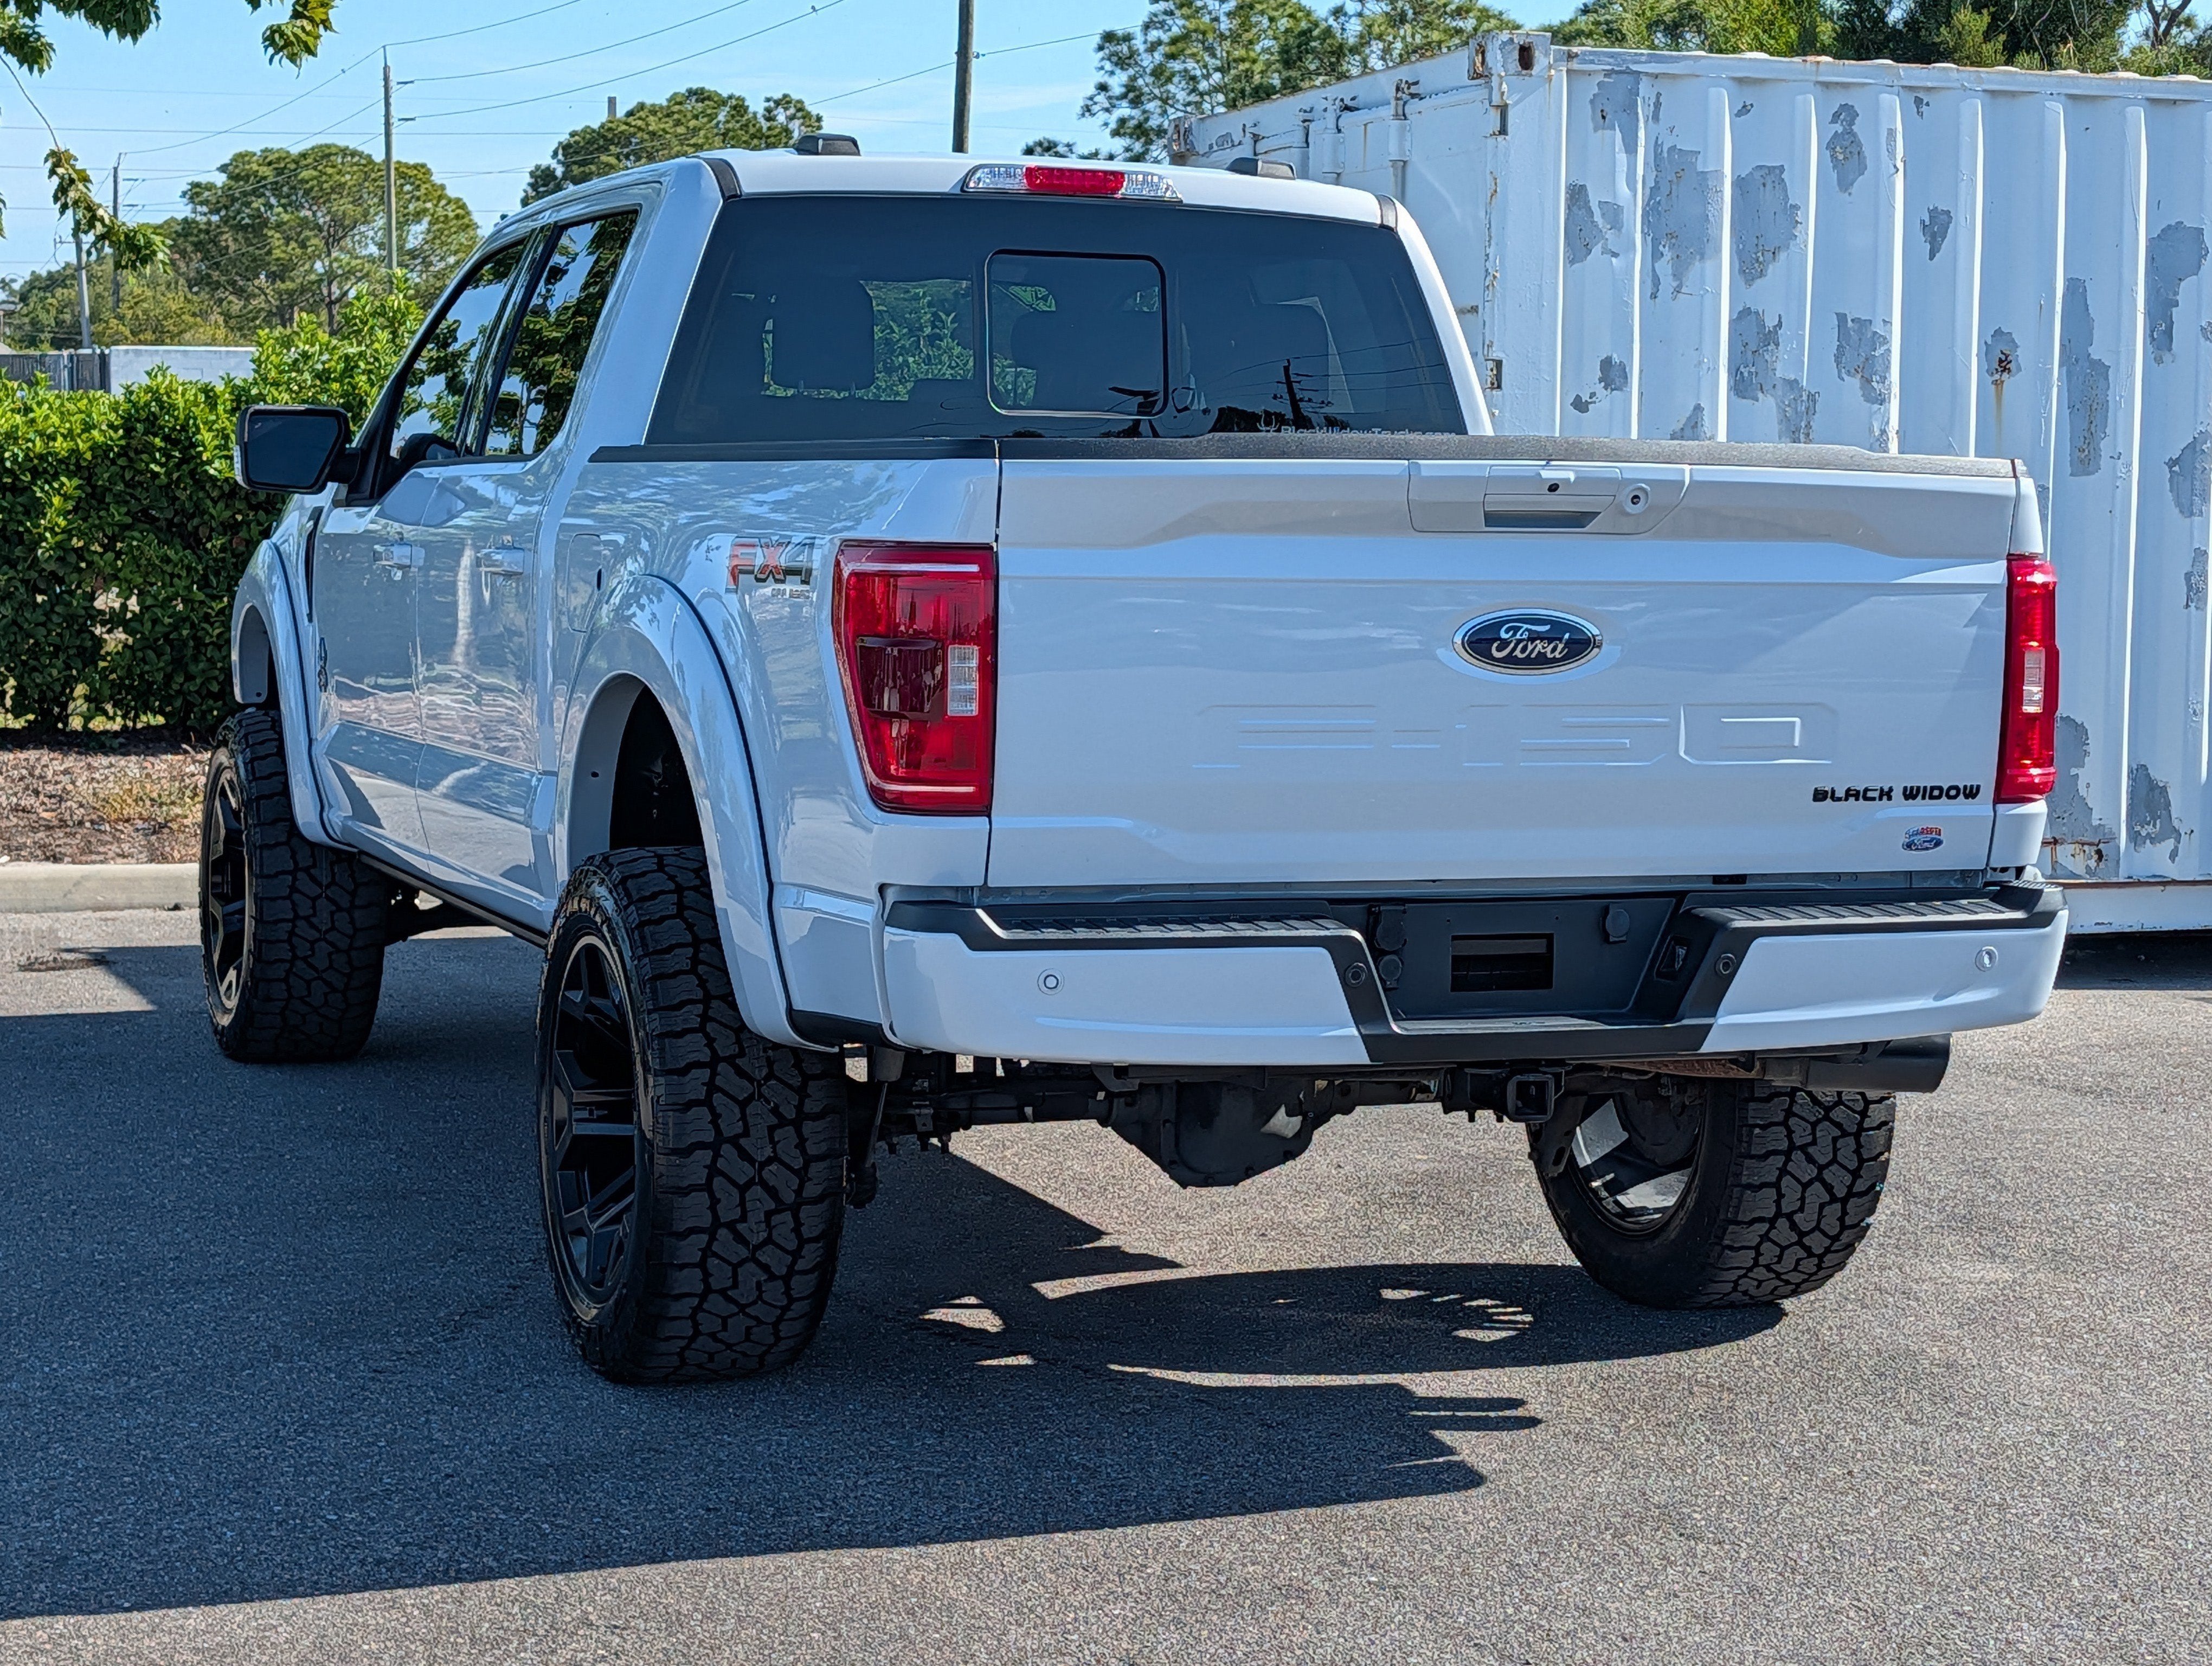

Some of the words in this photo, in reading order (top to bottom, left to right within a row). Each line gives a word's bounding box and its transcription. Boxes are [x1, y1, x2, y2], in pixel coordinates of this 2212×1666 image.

[1281, 426, 1457, 436] BlackWidowTruckscom
[725, 536, 815, 593] FX4
[1491, 623, 1571, 658] Ford
[1812, 785, 1894, 803] BLACK
[1901, 784, 1981, 801] WIDOW
